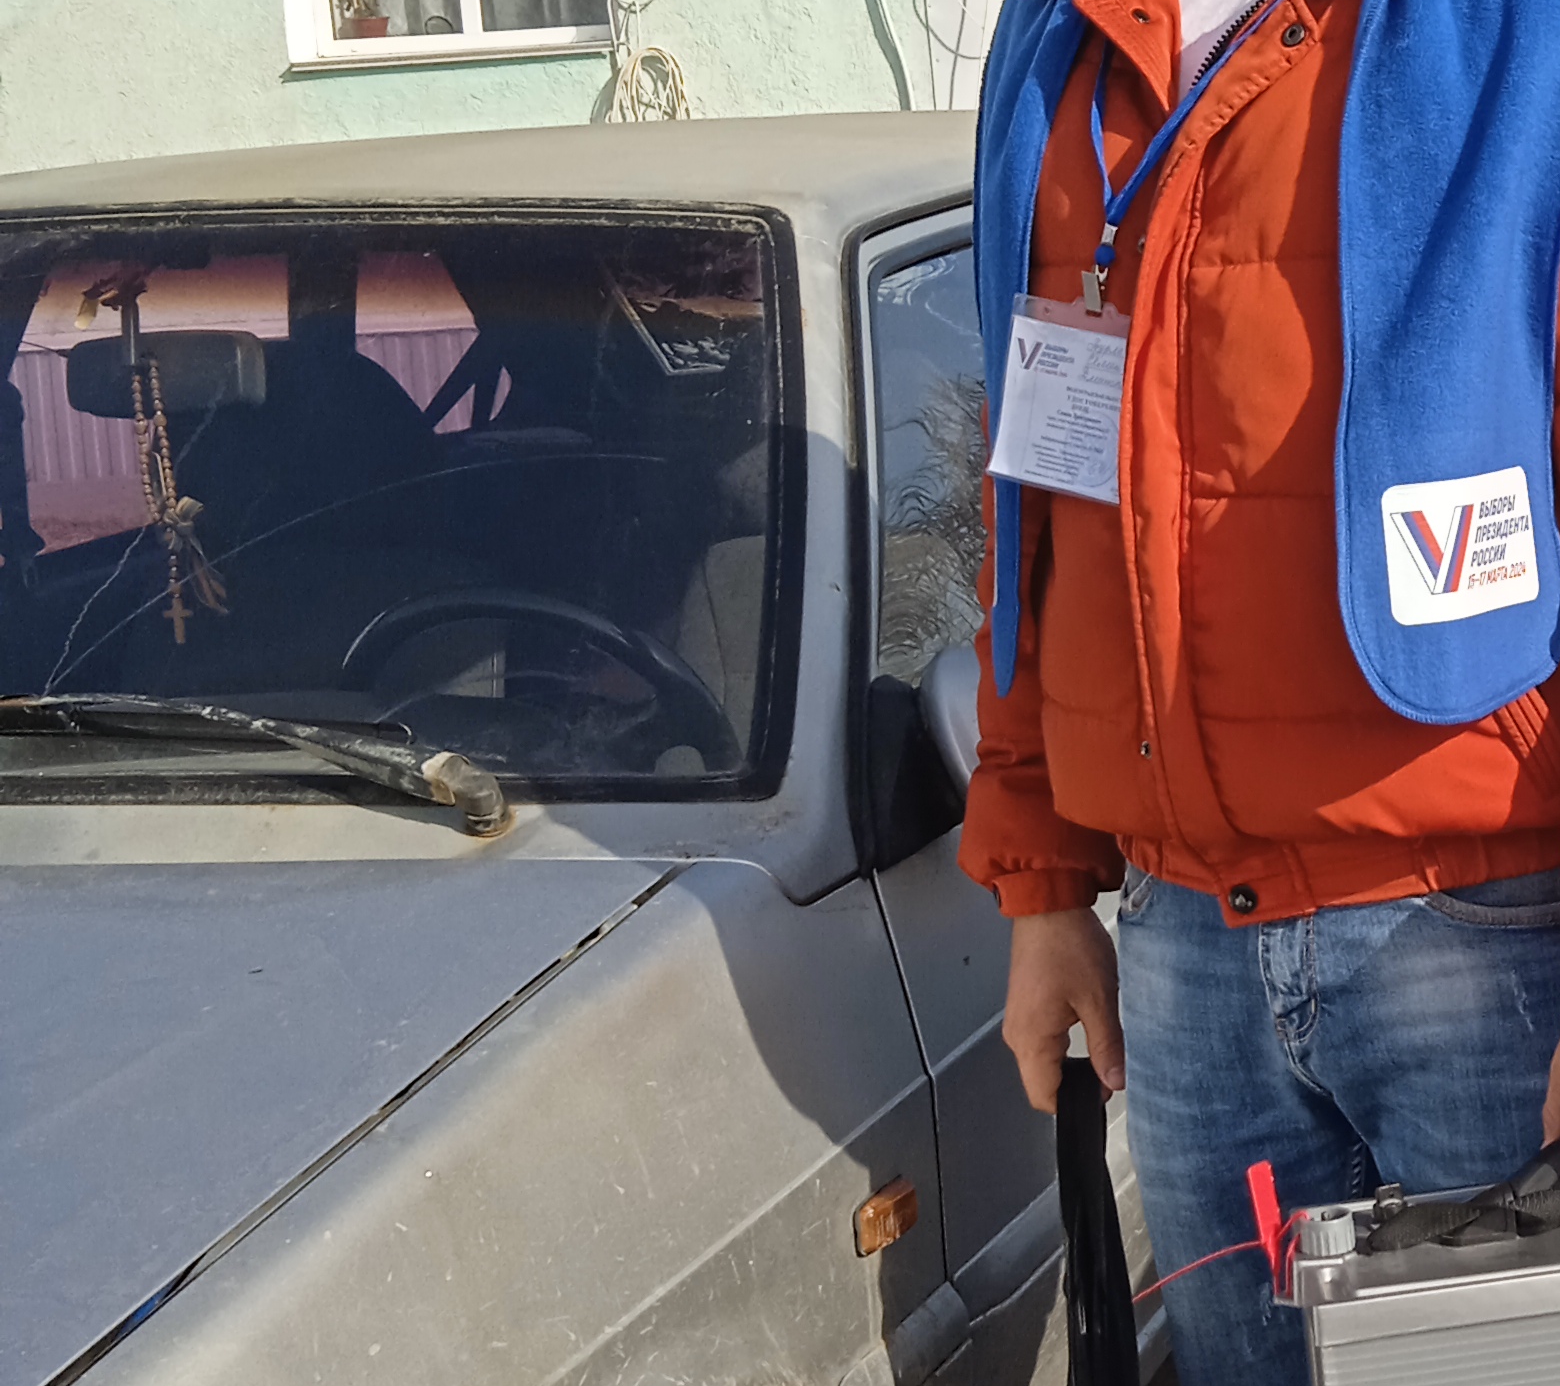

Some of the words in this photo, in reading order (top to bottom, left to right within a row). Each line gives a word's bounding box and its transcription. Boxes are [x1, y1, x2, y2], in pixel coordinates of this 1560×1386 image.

[1479, 494, 1516, 519] ВЫБОРЫ
[1474, 515, 1530, 544] ПРЕЗИДЕНТА
[1470, 543, 1507, 567] РОССИИ
